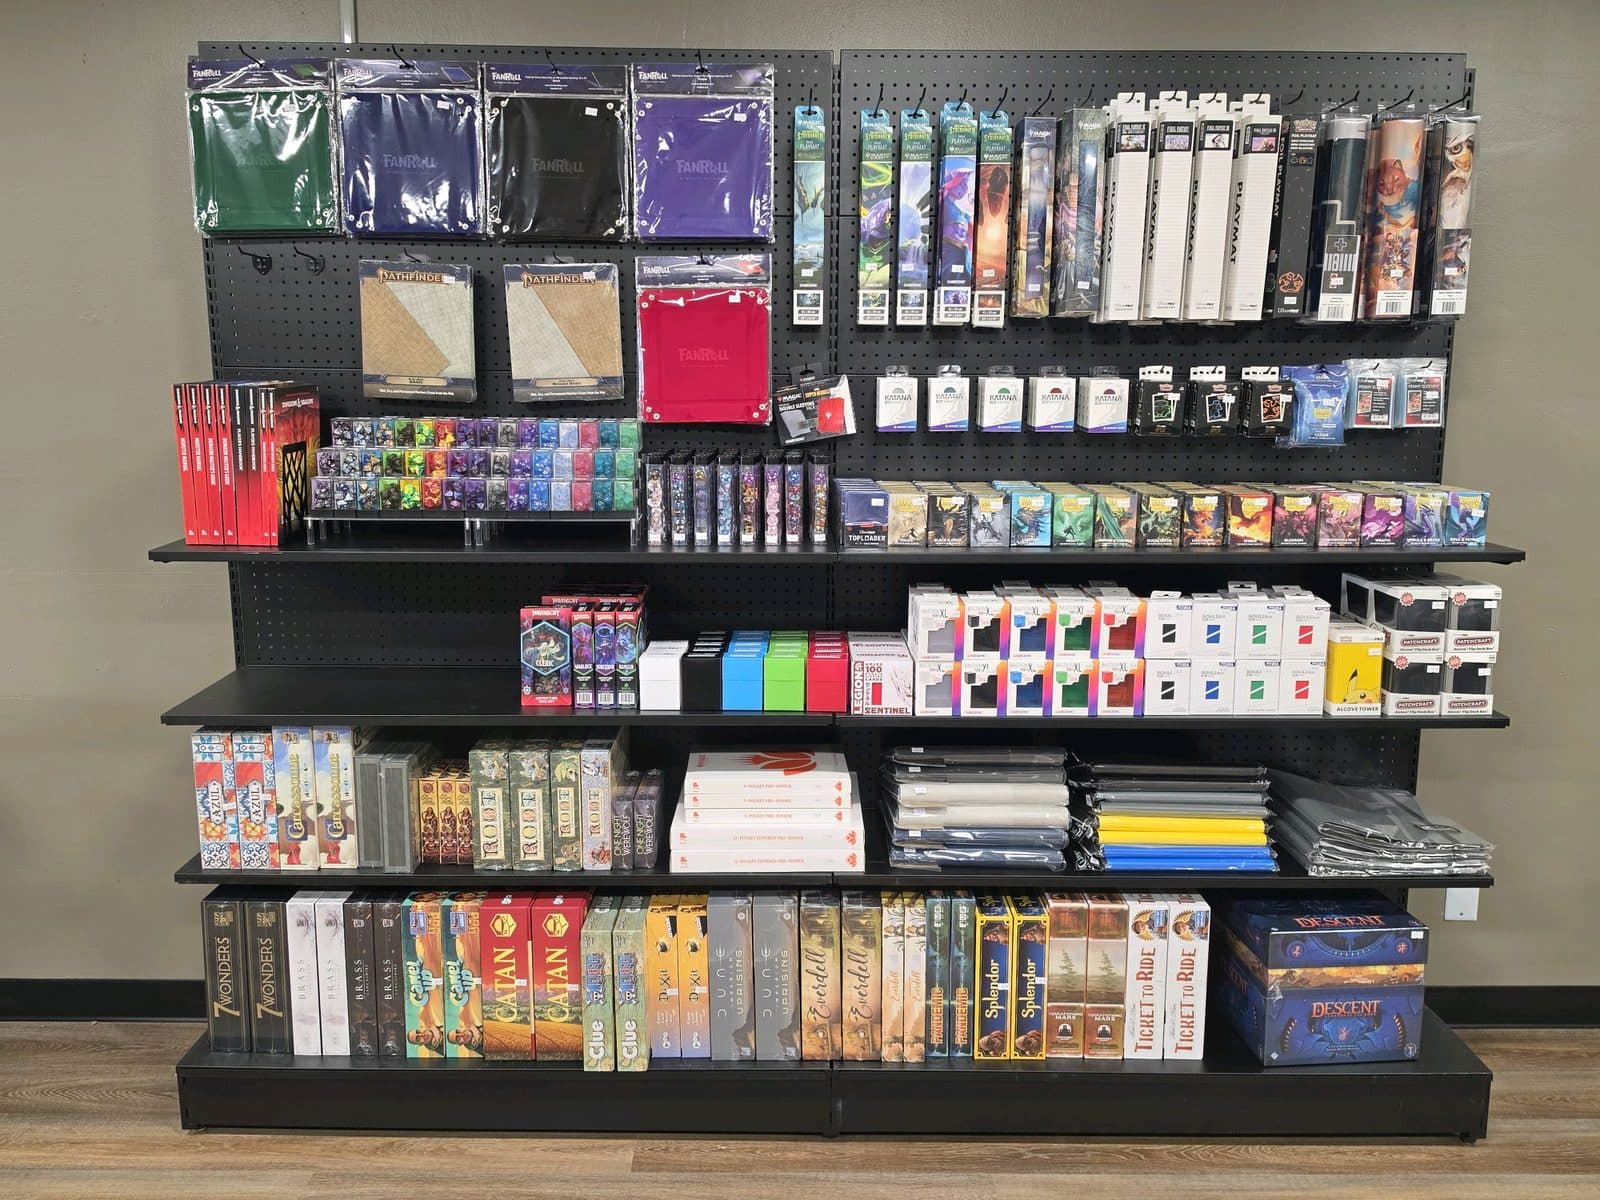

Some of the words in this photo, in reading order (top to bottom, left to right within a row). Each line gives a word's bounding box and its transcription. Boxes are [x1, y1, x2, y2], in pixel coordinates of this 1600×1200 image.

[491, 71, 522, 82] FANROLL
[638, 70, 669, 81] FANROLL
[383, 153, 438, 169] FANROLL
[531, 157, 585, 173] FANROLL
[676, 158, 729, 174] FANROLL
[1148, 179, 1159, 263] PLAYMAT
[1230, 181, 1244, 264] PLAYMAT
[378, 267, 441, 284] PATHFINDE
[643, 265, 671, 275] FANROLL
[1456, 637, 1493, 645] PATCHCRAFT
[854, 671, 864, 715] LEGION
[864, 707, 911, 715] SENTINEL
[1450, 700, 1486, 708] PATCHCRAFT
[212, 787, 221, 817] AZUL
[251, 787, 262, 817] AZUL
[288, 753, 305, 839] Carcassonne
[328, 753, 345, 839] Carcassonne
[559, 790, 571, 834] ROOT
[589, 790, 601, 836] ROOT
[481, 791, 499, 858] ROOT
[520, 792, 538, 859] ROOT
[614, 815, 622, 838] NIGHT
[622, 814, 632, 856] WEREWOLF
[636, 814, 644, 837] NIGHT
[644, 813, 653, 855] WEREWOLF
[614, 838, 622, 857] ONE
[636, 837, 644, 856] ONE
[1293, 915, 1387, 929] DESCENT
[217, 937, 232, 1006] WONDERS
[259, 937, 275, 1007] WONDERS
[296, 959, 306, 1000] BRASS
[326, 959, 336, 1000] BRASS
[353, 959, 364, 1000] BRASS
[382, 959, 393, 1000] BRASS
[493, 946, 518, 1023] CATAN
[545, 946, 570, 1023] CATAN
[715, 946, 727, 1018] DUNE
[735, 949, 744, 1015] UPRISING
[761, 946, 773, 1018] DUNE
[781, 949, 790, 1015] UPRISING
[805, 947, 832, 1023] Everdell
[847, 947, 873, 1023] Everdell
[1136, 948, 1156, 981] RIDE
[1176, 948, 1197, 982] RIDE
[982, 958, 1006, 1019] Splendor
[1018, 958, 1042, 1019] Splendor
[1142, 984, 1154, 998] TO
[1182, 985, 1194, 998] TO
[1311, 999, 1381, 1018] DESCENT
[213, 1001, 241, 1018] 7
[256, 1002, 284, 1019] 7
[930, 987, 944, 1045] PANDEMIC
[954, 987, 968, 1045] PANDEMIC
[1134, 1000, 1155, 1053] TICKET
[1174, 1001, 1195, 1054] TICKET
[588, 1020, 605, 1060] Clue
[622, 1020, 638, 1060] Clue
